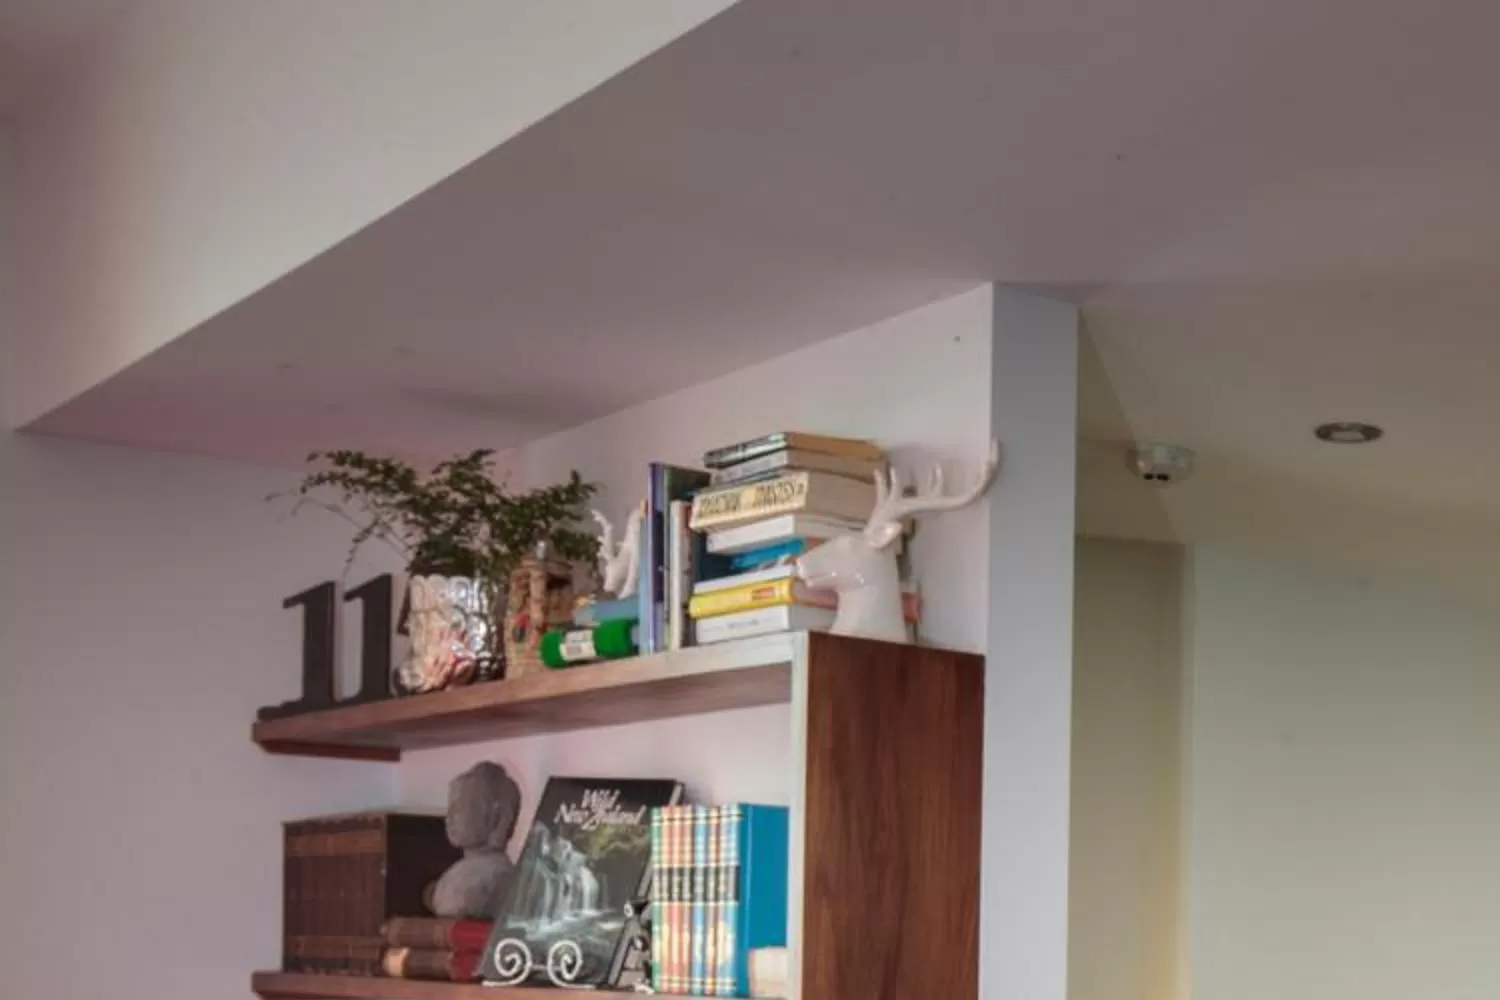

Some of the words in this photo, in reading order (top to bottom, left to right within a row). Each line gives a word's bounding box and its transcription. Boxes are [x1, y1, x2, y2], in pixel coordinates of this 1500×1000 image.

[257, 572, 412, 719] 11
[580, 788, 622, 809] Wild
[553, 801, 592, 825] New
[580, 803, 647, 832] Zealand
